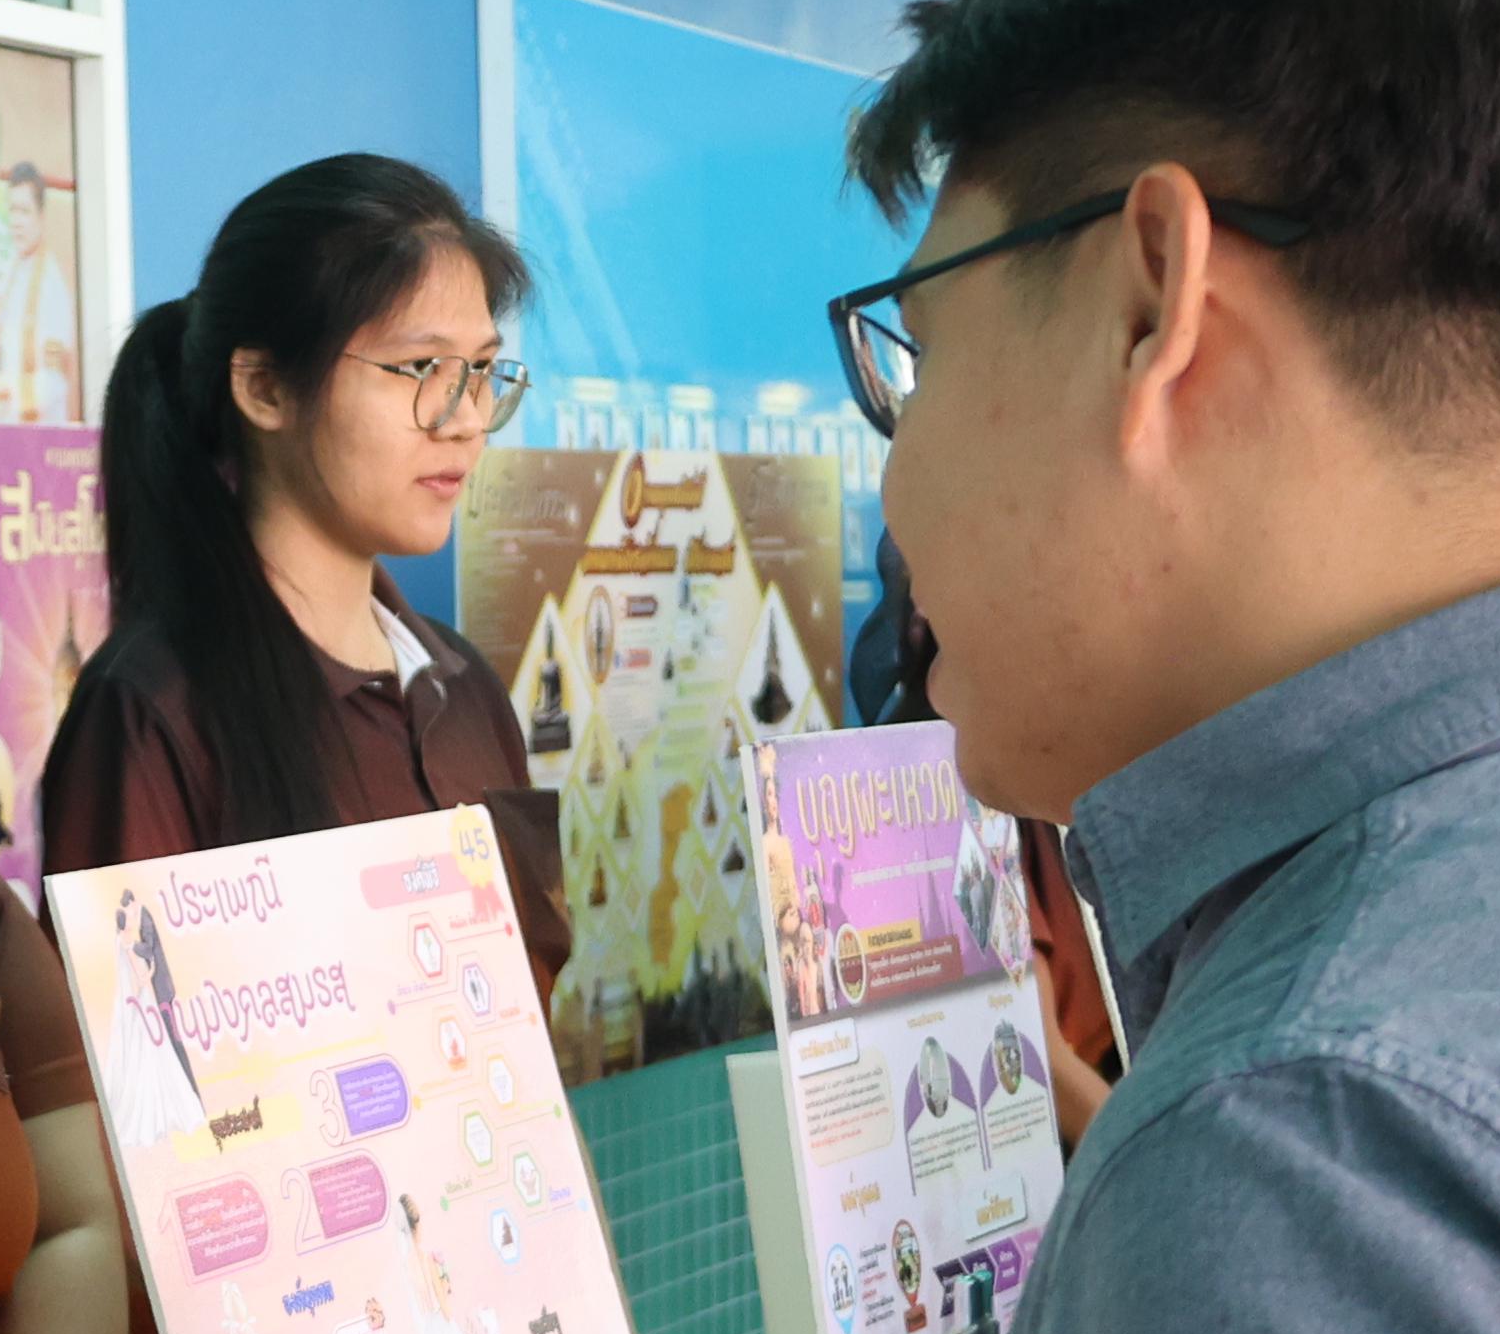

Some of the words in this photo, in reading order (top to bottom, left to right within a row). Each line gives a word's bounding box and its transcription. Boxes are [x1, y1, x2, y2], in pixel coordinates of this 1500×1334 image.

[459, 827, 490, 863] 45
[159, 854, 283, 928] ประเพณี
[125, 960, 357, 1051] งานมงคลสมรส
